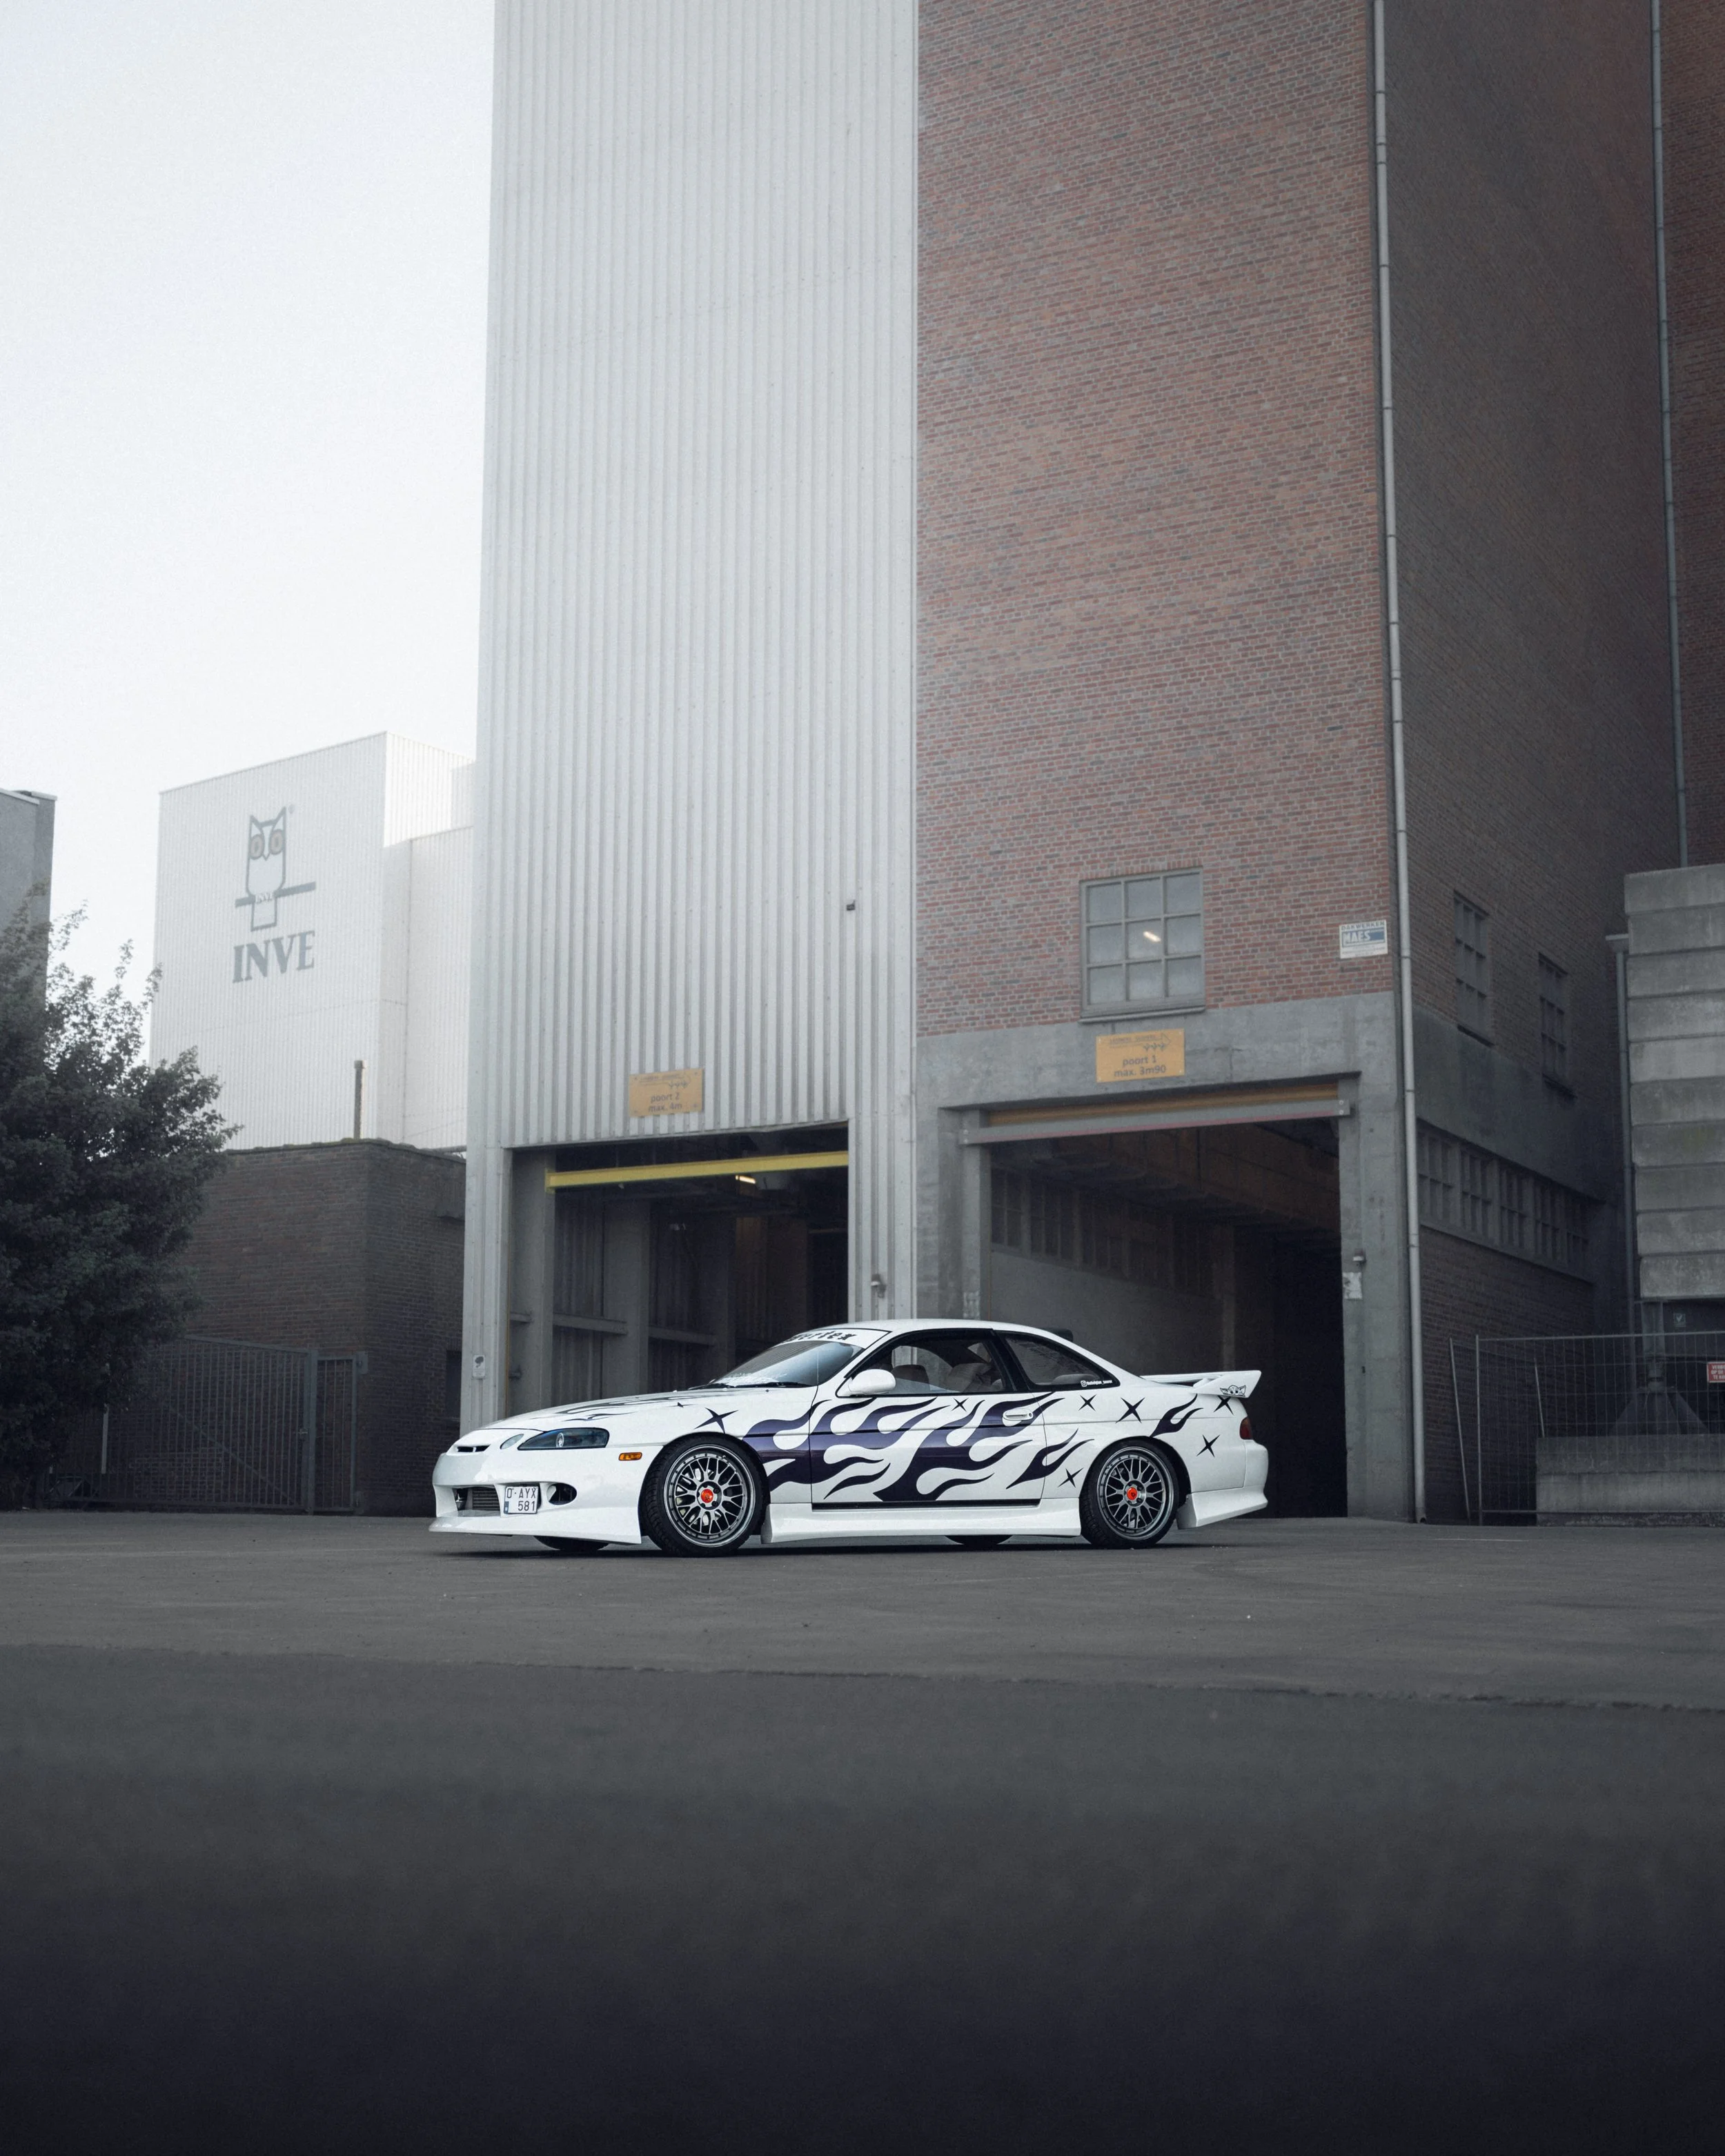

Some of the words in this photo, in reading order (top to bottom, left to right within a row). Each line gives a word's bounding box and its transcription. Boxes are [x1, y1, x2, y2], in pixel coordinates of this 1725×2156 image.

[1343, 930, 1371, 945] MAES
[232, 930, 315, 984] INVE
[1123, 1056, 1149, 1067] poort
[1152, 1054, 1156, 1063] 1
[1140, 1065, 1166, 1076] 3m90
[651, 1094, 673, 1103] poort
[518, 1501, 535, 1511] 581
